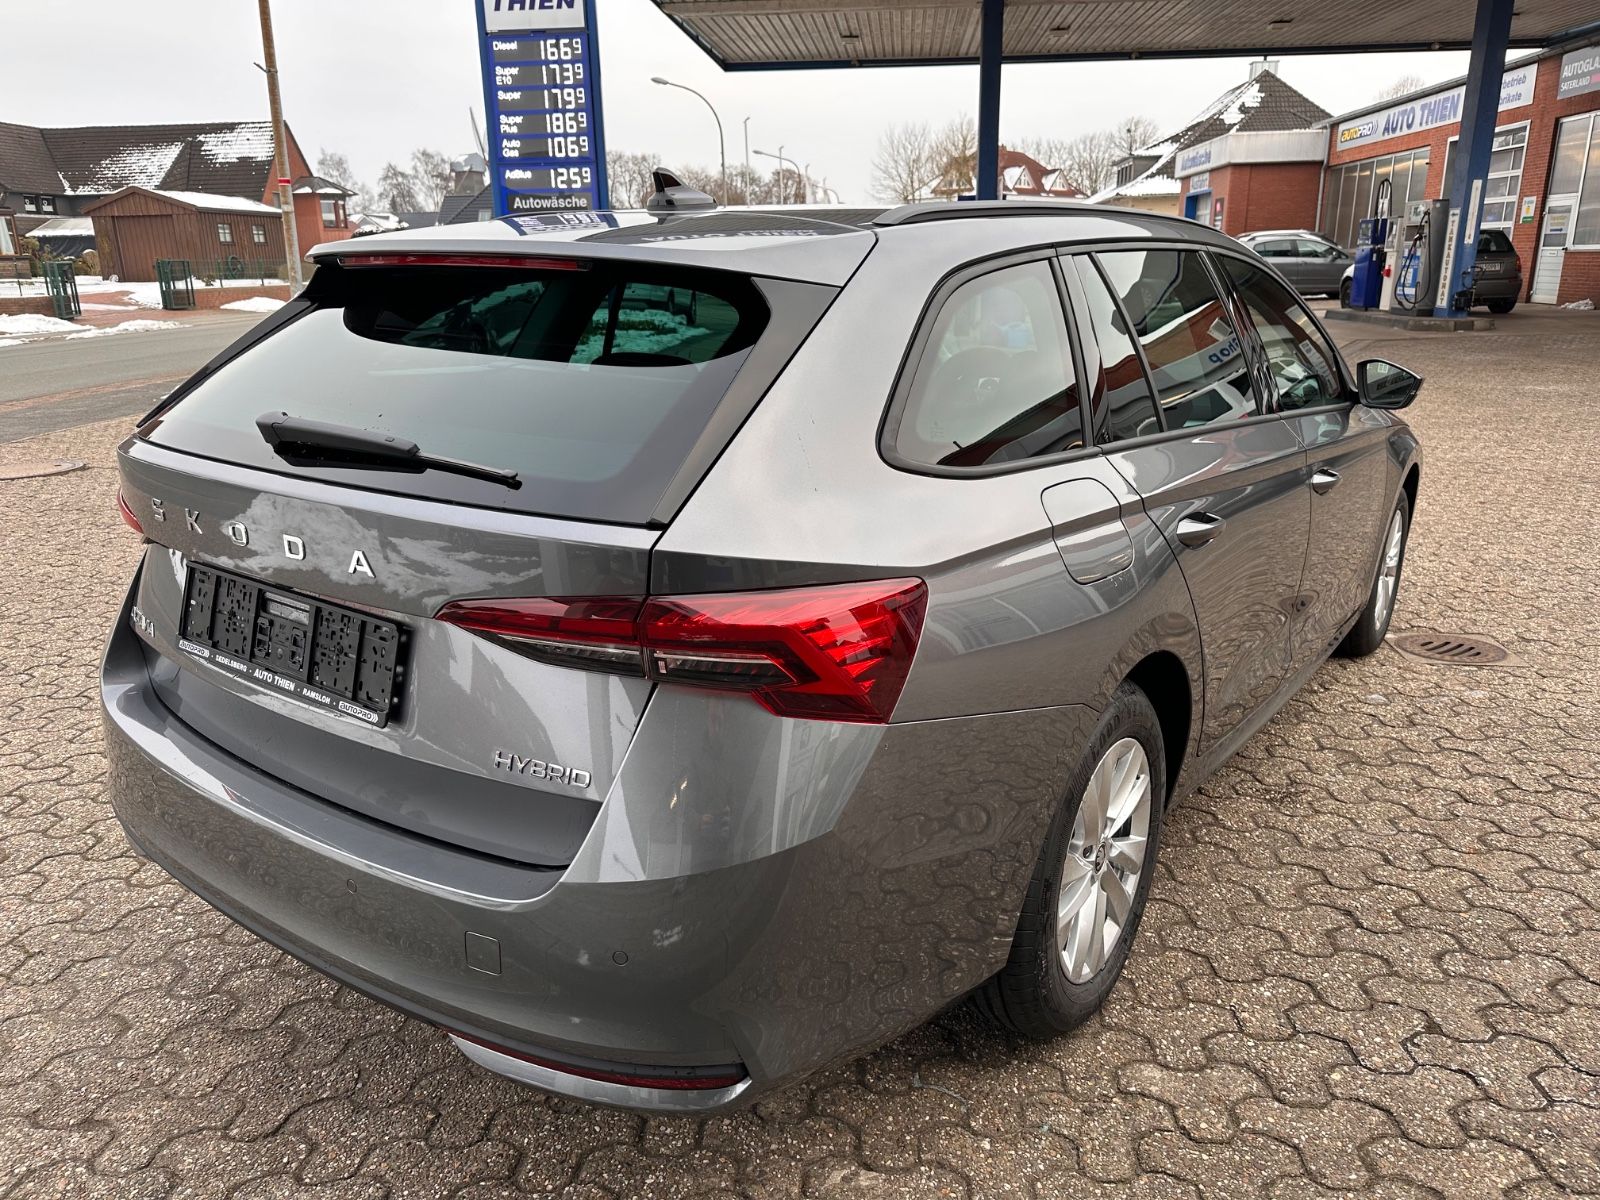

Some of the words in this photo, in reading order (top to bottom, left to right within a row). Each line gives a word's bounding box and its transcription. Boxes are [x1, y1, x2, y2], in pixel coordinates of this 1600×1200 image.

[493, 41, 518, 50] Diesel
[495, 66, 520, 76] Super
[1563, 56, 1600, 78] AUTOGLA
[496, 76, 513, 85] E10
[1502, 73, 1527, 89] betrieb
[1560, 76, 1591, 92] SATERLAND
[497, 90, 522, 101] Super
[499, 114, 524, 125] Super
[1382, 107, 1416, 136] AUTO
[1419, 93, 1461, 127] THIEN
[500, 124, 519, 133] Plus
[502, 138, 521, 148] Auto
[502, 148, 520, 157] Gas
[505, 169, 533, 179] AdBlue
[513, 196, 588, 209] Autowäsche
[253, 667, 273, 683] AUTO
[274, 674, 296, 692] THIEN
[302, 688, 331, 705] RAMSLOH
[494, 751, 591, 788] HYBRID
